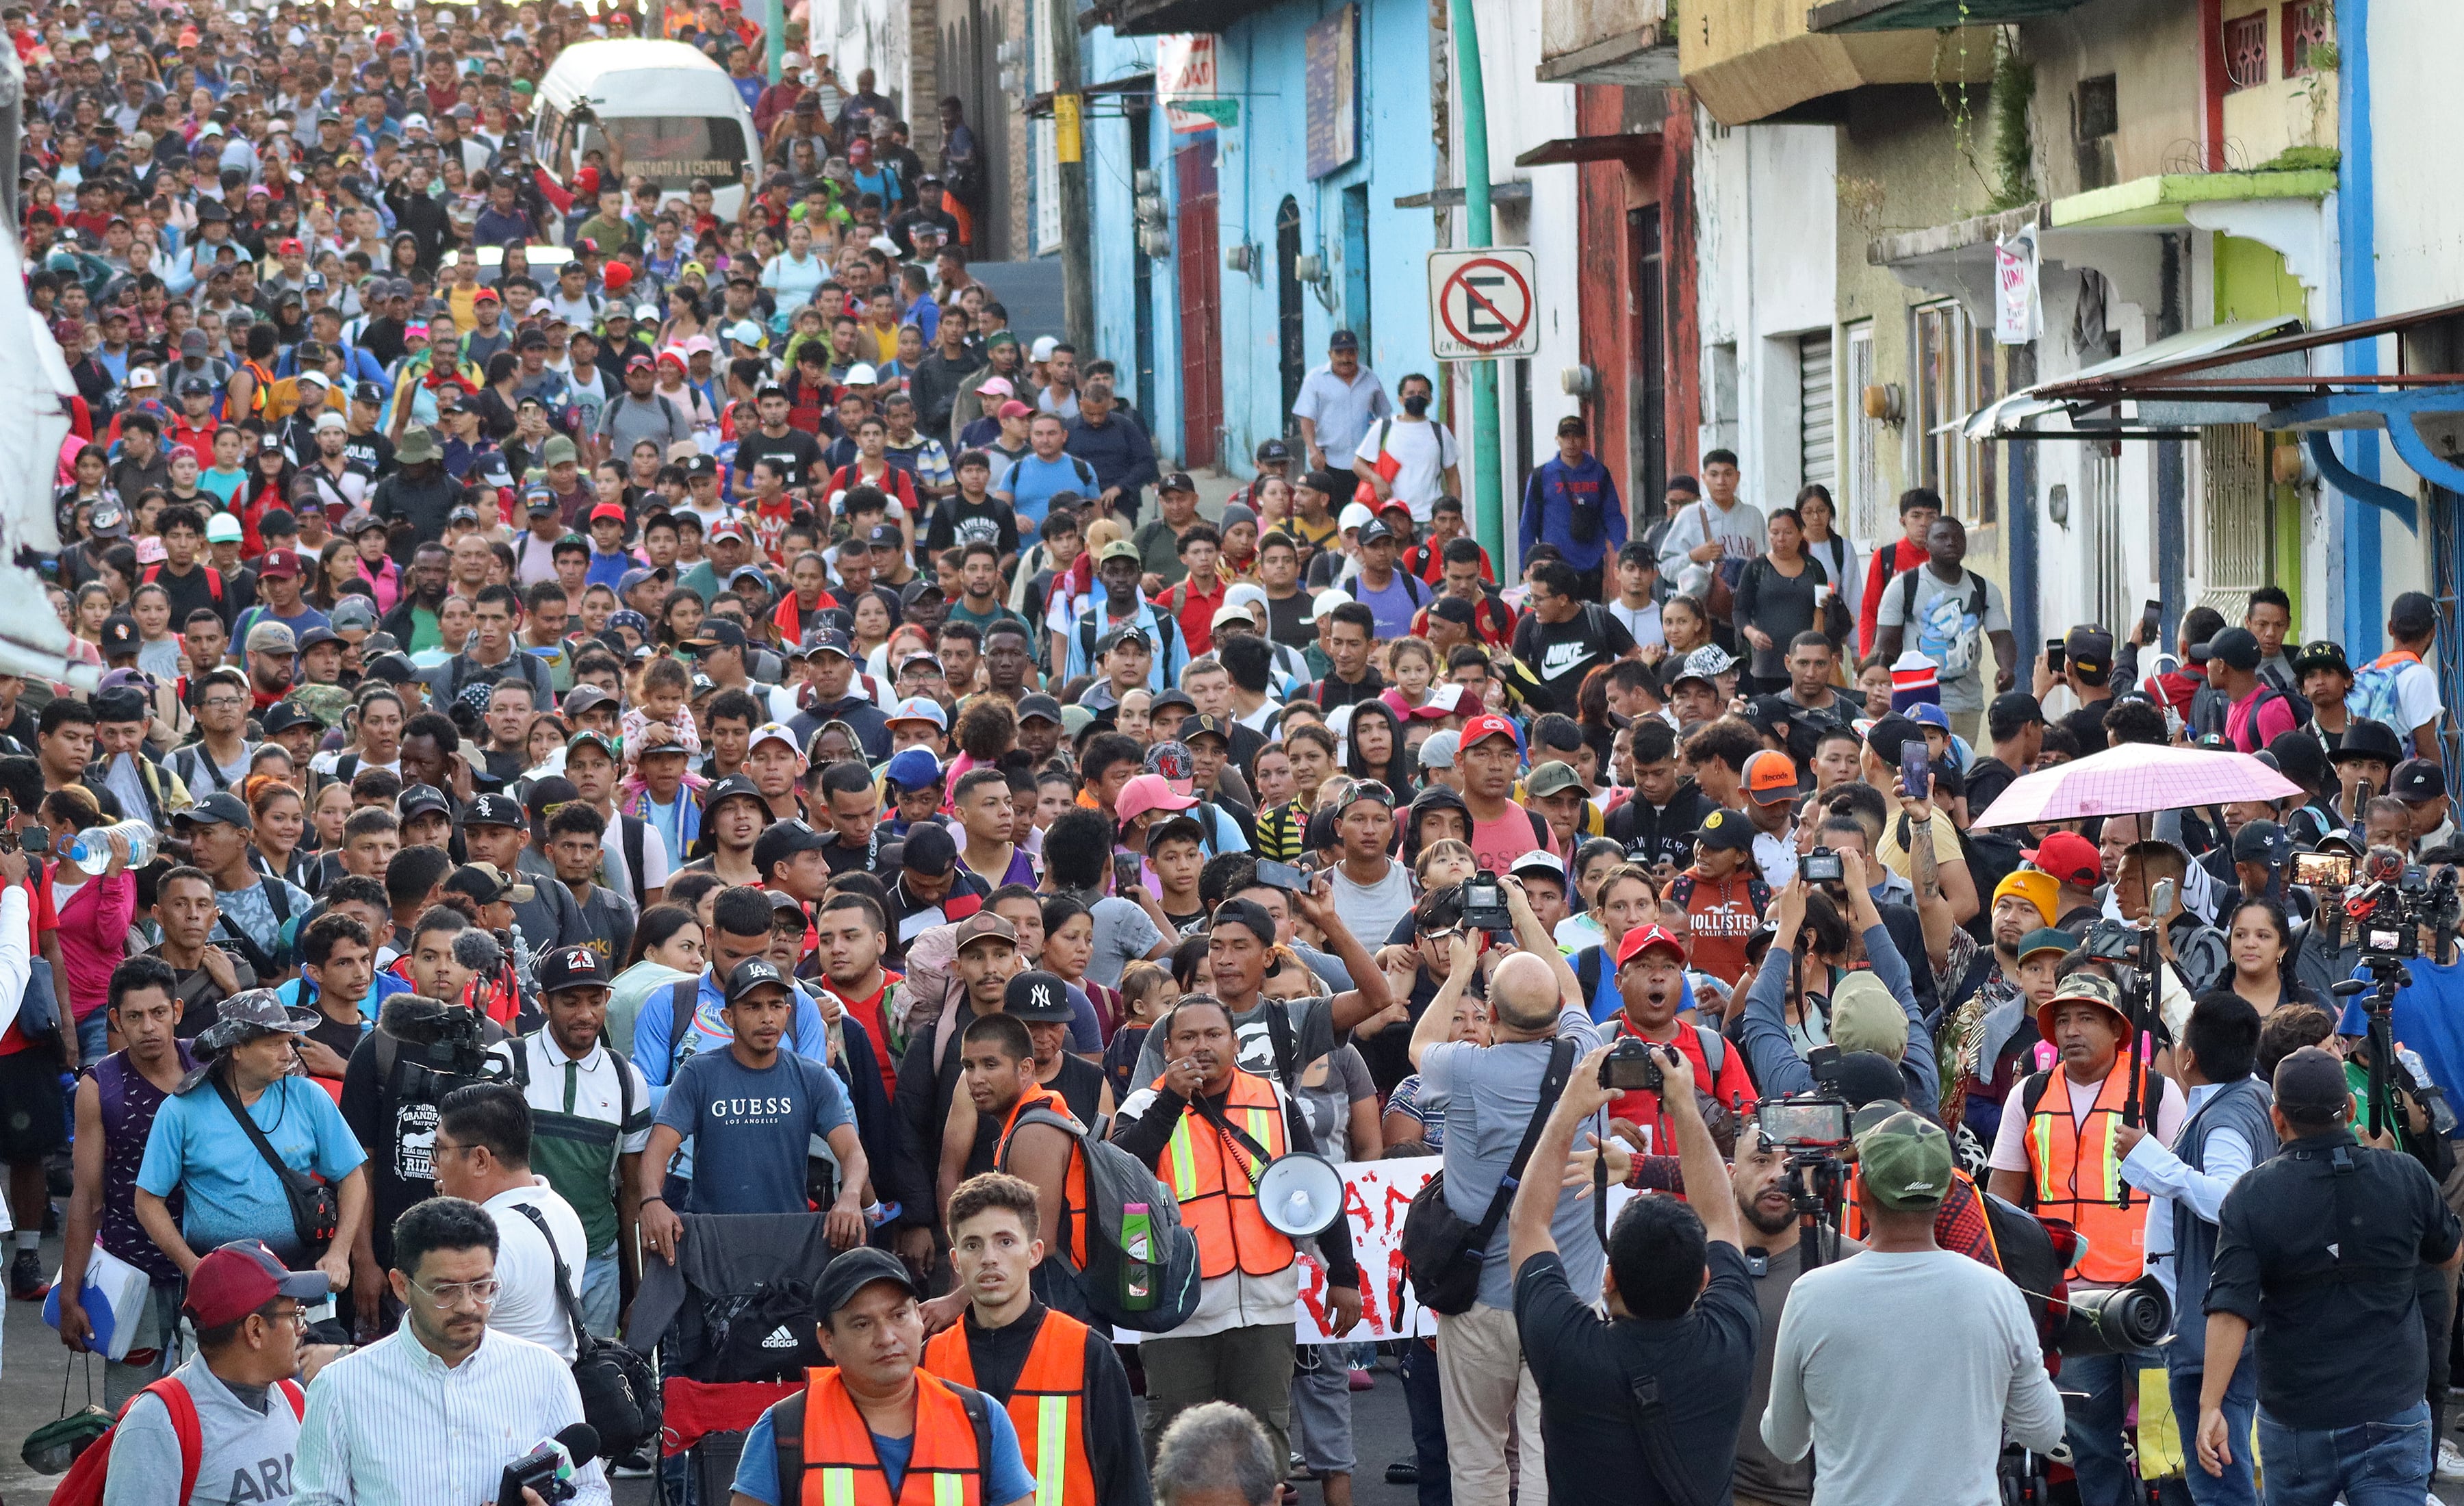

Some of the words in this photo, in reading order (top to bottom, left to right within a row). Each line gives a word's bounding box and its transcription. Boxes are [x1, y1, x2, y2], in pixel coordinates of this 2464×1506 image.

[1439, 341, 1452, 352] EN
[1545, 641, 1584, 665] NIKE
[1031, 984, 1052, 1008] NY
[711, 1097, 792, 1117] GUESS
[762, 1338, 798, 1348] adidas
